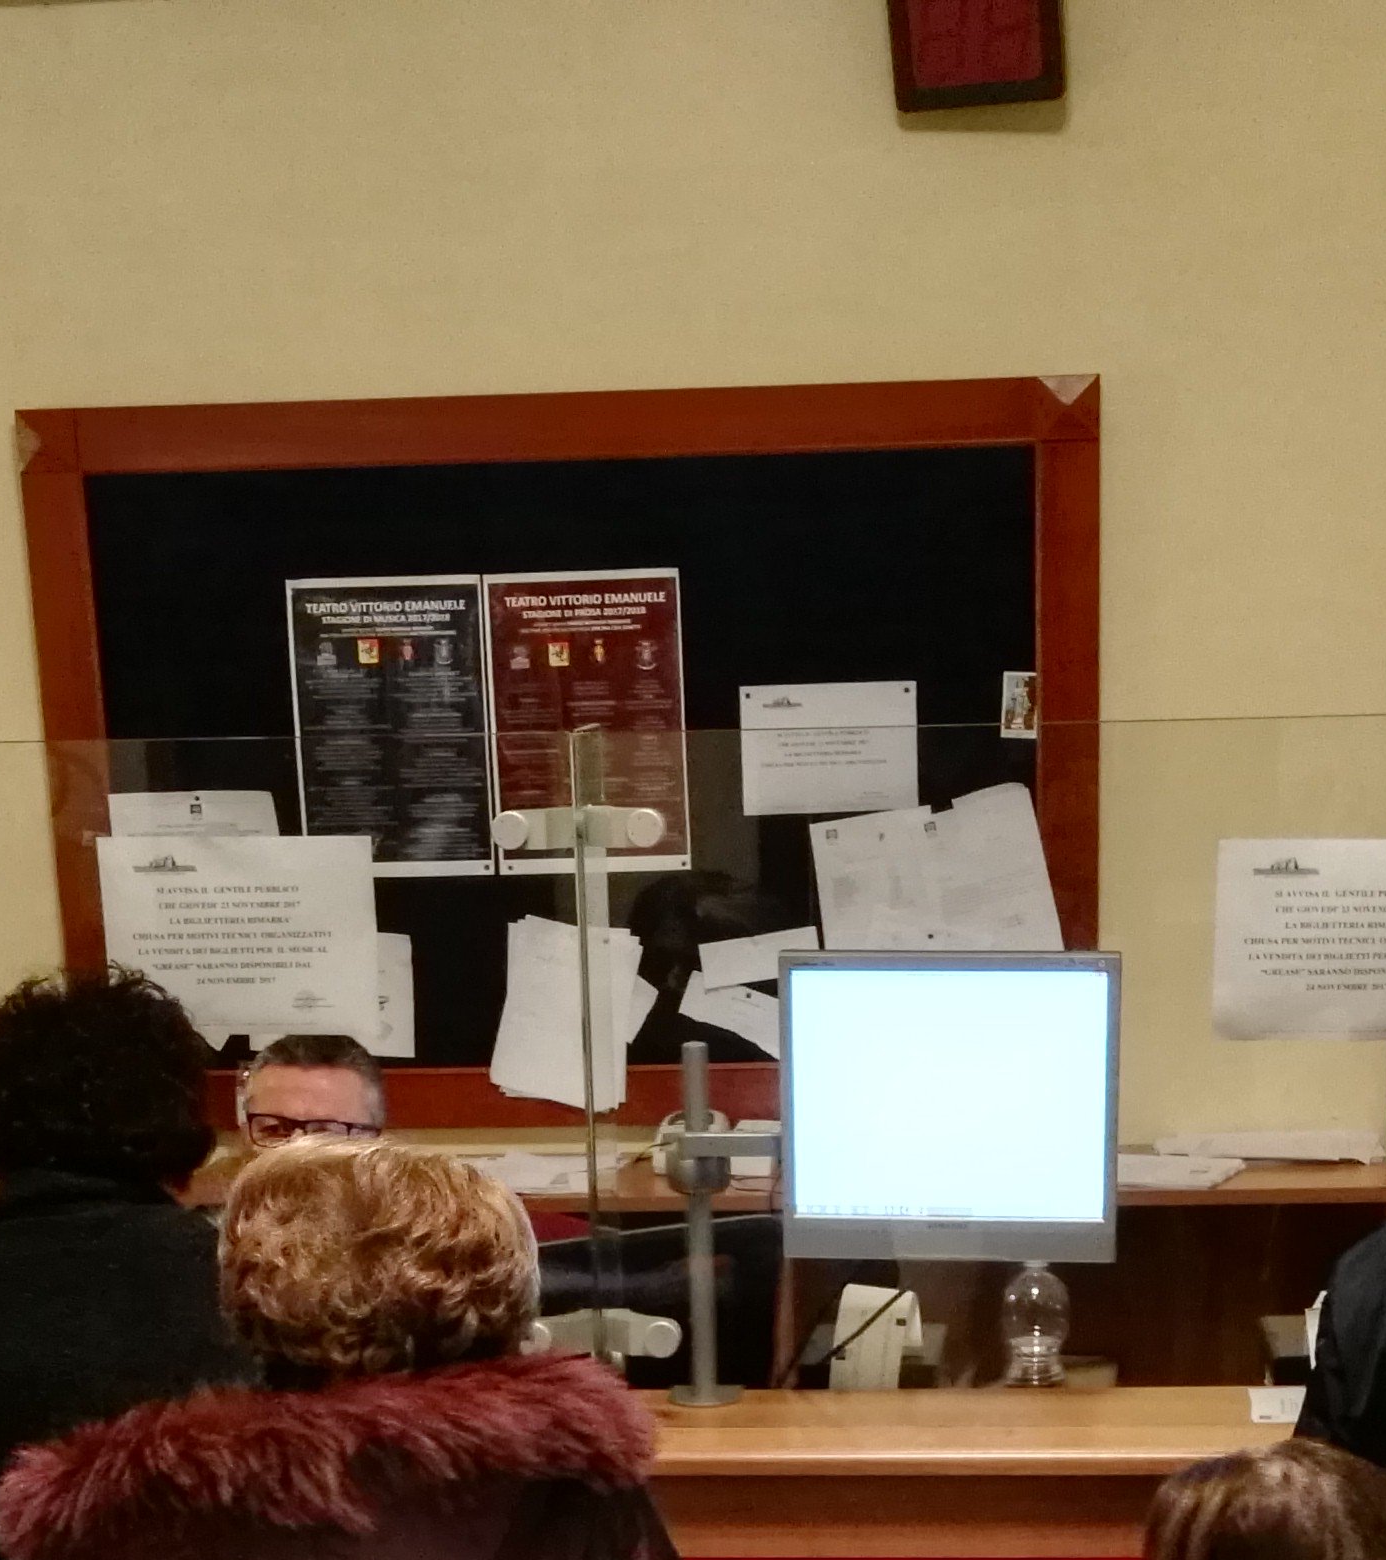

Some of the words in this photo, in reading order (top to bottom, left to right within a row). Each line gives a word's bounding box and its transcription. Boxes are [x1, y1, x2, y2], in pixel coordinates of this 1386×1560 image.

[305, 602, 348, 614] TEATRO
[350, 601, 402, 613] VITTORIO
[404, 599, 466, 611] EMANUELE
[504, 596, 547, 608] TEATRO
[549, 594, 602, 606] VITTORIO
[604, 592, 666, 604] EMANUELE
